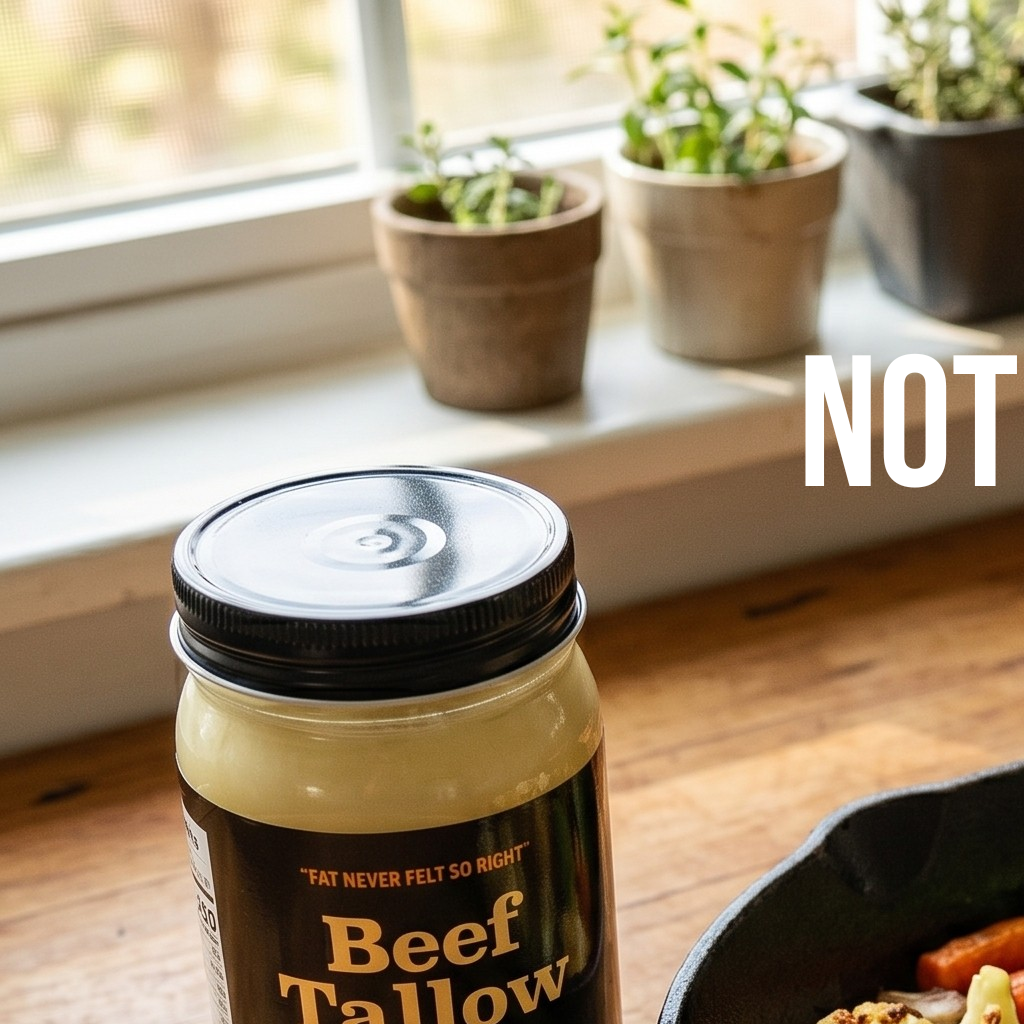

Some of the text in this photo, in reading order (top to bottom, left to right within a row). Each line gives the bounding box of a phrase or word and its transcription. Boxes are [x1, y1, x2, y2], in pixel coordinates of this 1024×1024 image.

[343, 871, 401, 889] NEVER
[405, 865, 445, 886] FELT
[449, 861, 472, 880] SO
[321, 889, 524, 974] Beef
